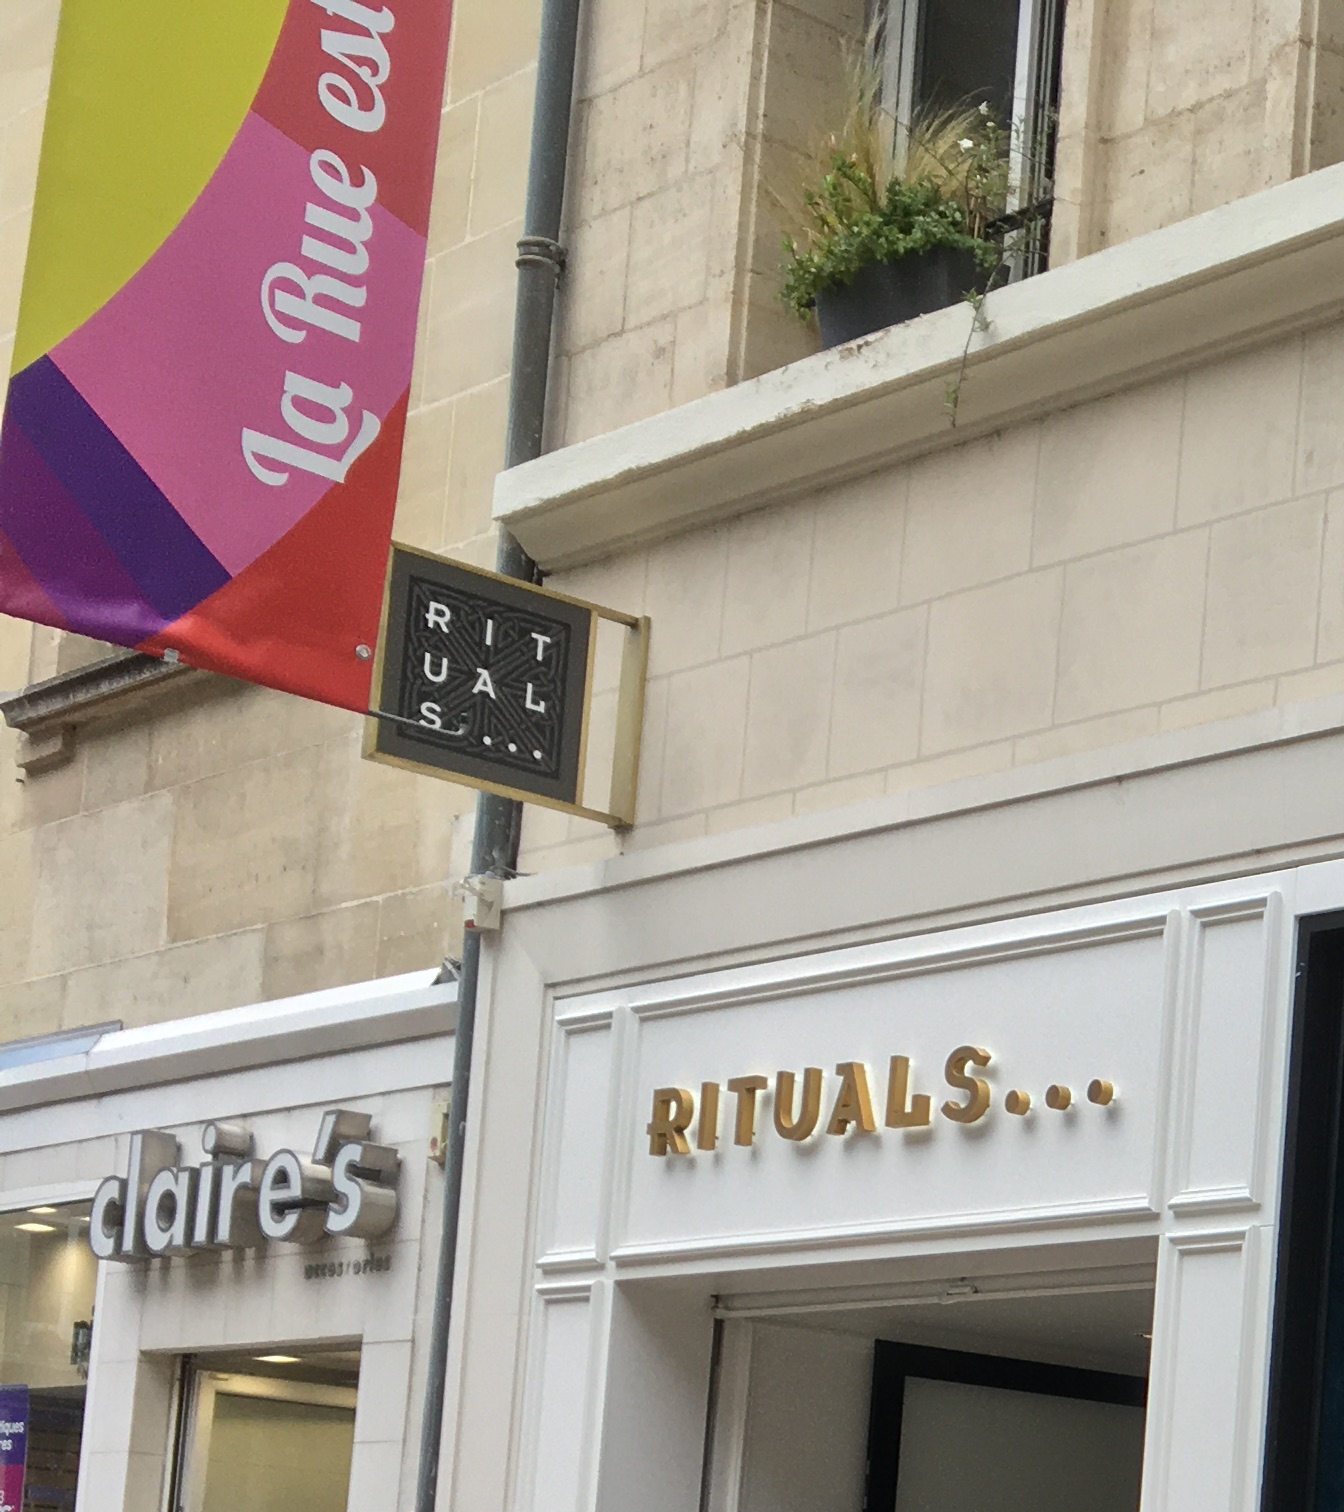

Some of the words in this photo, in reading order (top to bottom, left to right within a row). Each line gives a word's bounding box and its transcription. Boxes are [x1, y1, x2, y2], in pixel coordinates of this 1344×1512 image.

[260, 148, 378, 344] Rue
[242, 370, 381, 487] La
[90, 1109, 396, 1261] claire's
